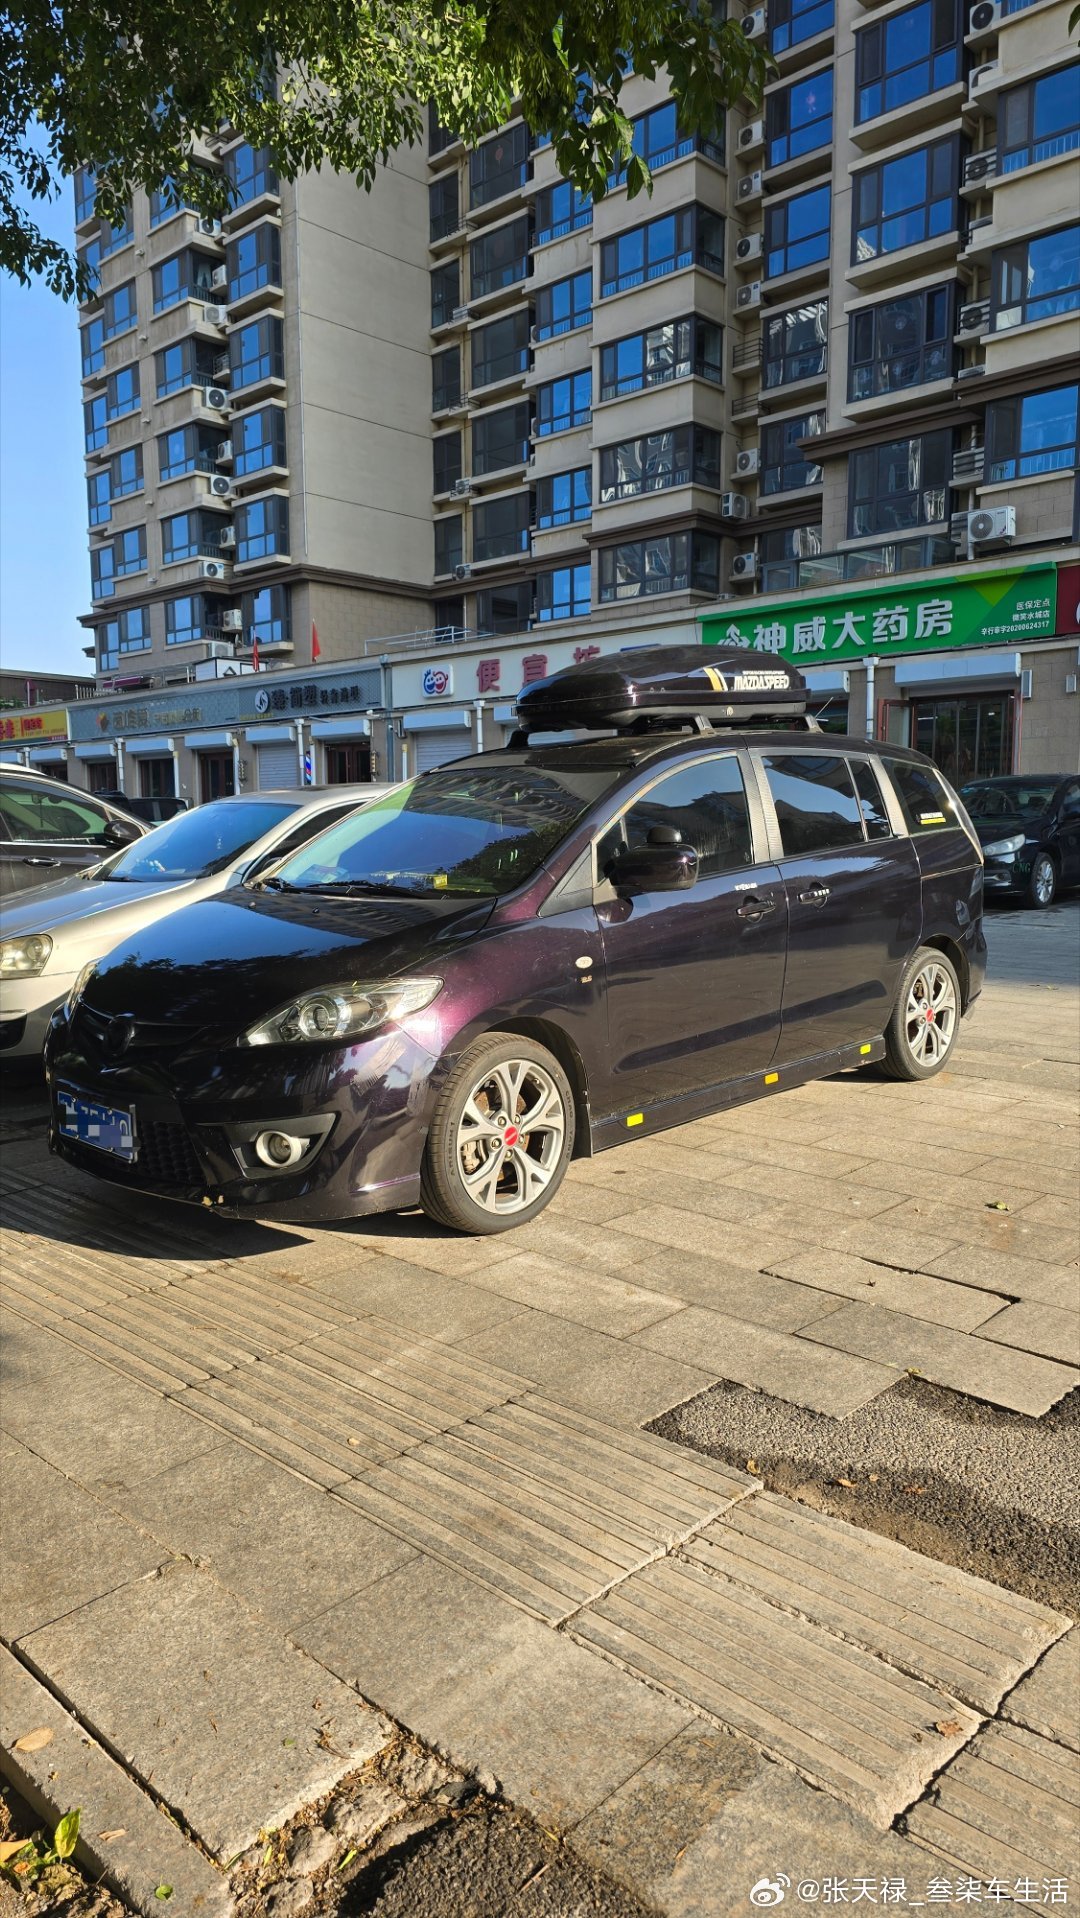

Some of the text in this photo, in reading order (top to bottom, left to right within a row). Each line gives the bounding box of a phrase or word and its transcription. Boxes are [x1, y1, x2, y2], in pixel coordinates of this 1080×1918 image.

[1016, 598, 1050, 611] 医保定点
[1012, 610, 1050, 622] 微笑水城店
[753, 598, 953, 654] 神威大药房
[734, 675, 789, 691] MAZDASPEED
[1013, 862, 1031, 873] CNG
